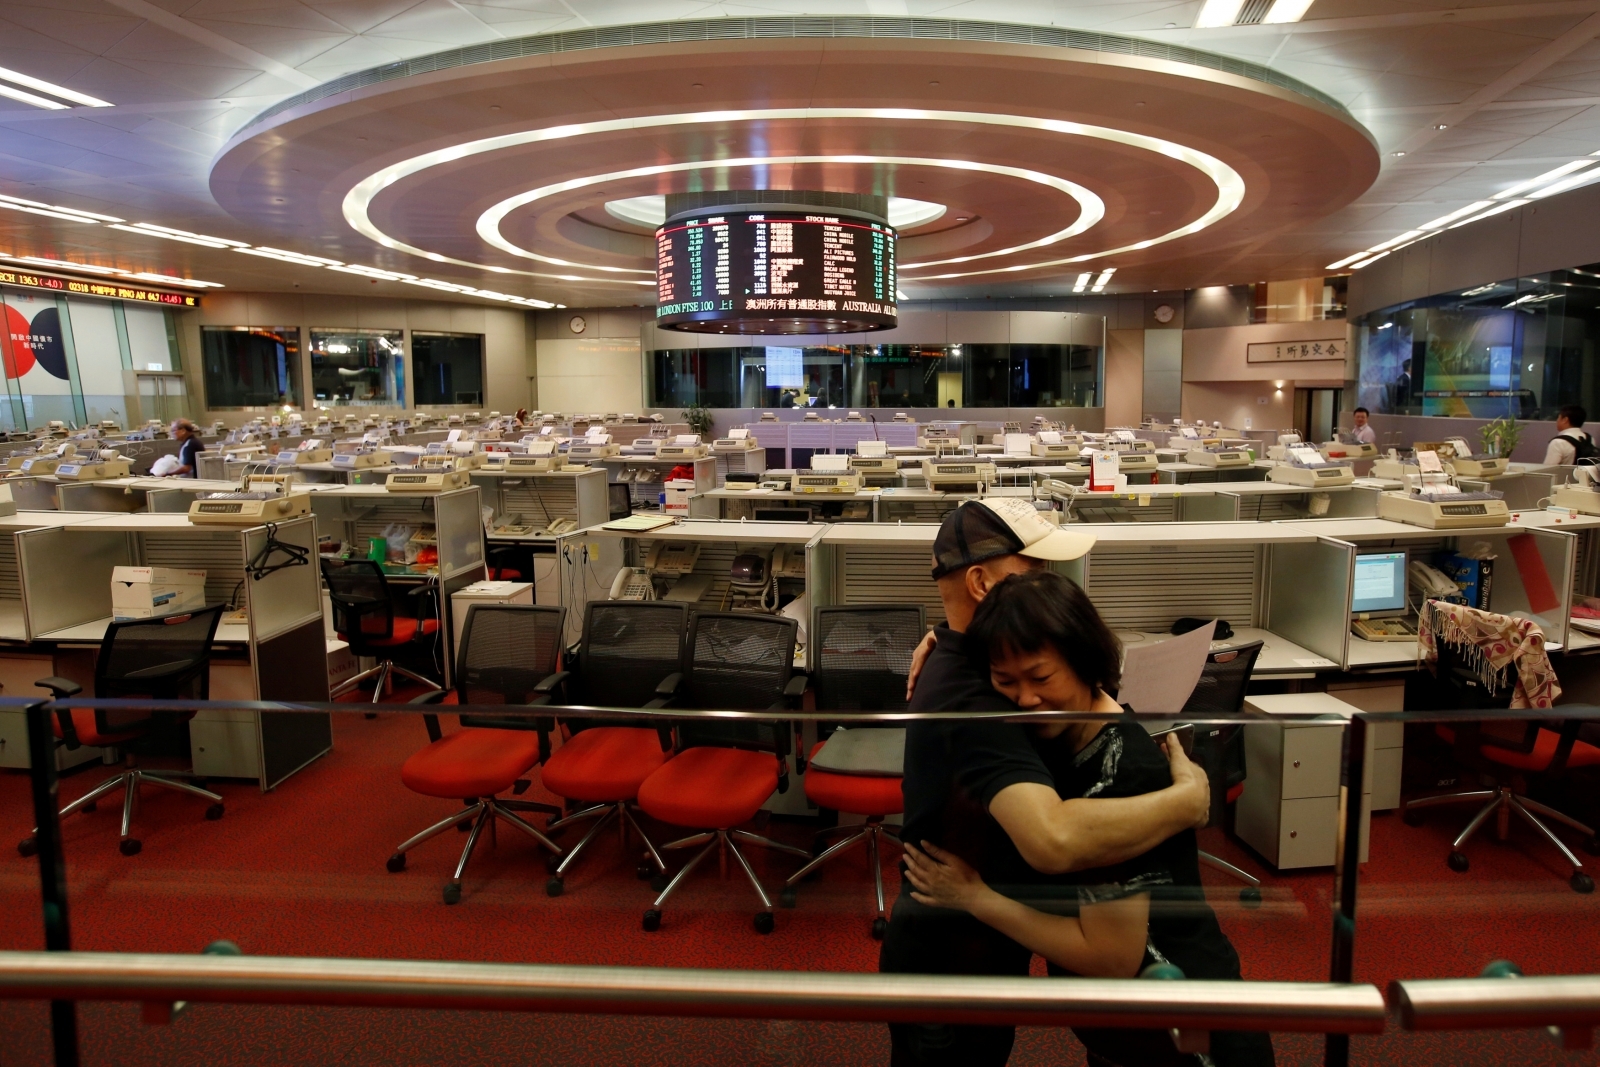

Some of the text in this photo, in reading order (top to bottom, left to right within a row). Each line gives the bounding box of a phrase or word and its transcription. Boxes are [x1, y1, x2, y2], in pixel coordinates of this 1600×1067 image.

[19, 275, 38, 285] 136.3
[69, 282, 88, 292] 02318
[118, 289, 134, 298] PING
[136, 291, 145, 300] AN
[662, 304, 681, 315] LONDON
[682, 302, 698, 312] FTSE
[701, 301, 714, 311] 100
[746, 299, 836, 310] 澳洲所有普通股指數
[842, 301, 882, 314] AUSTRALIA
[1287, 343, 1346, 358] 合交易所
